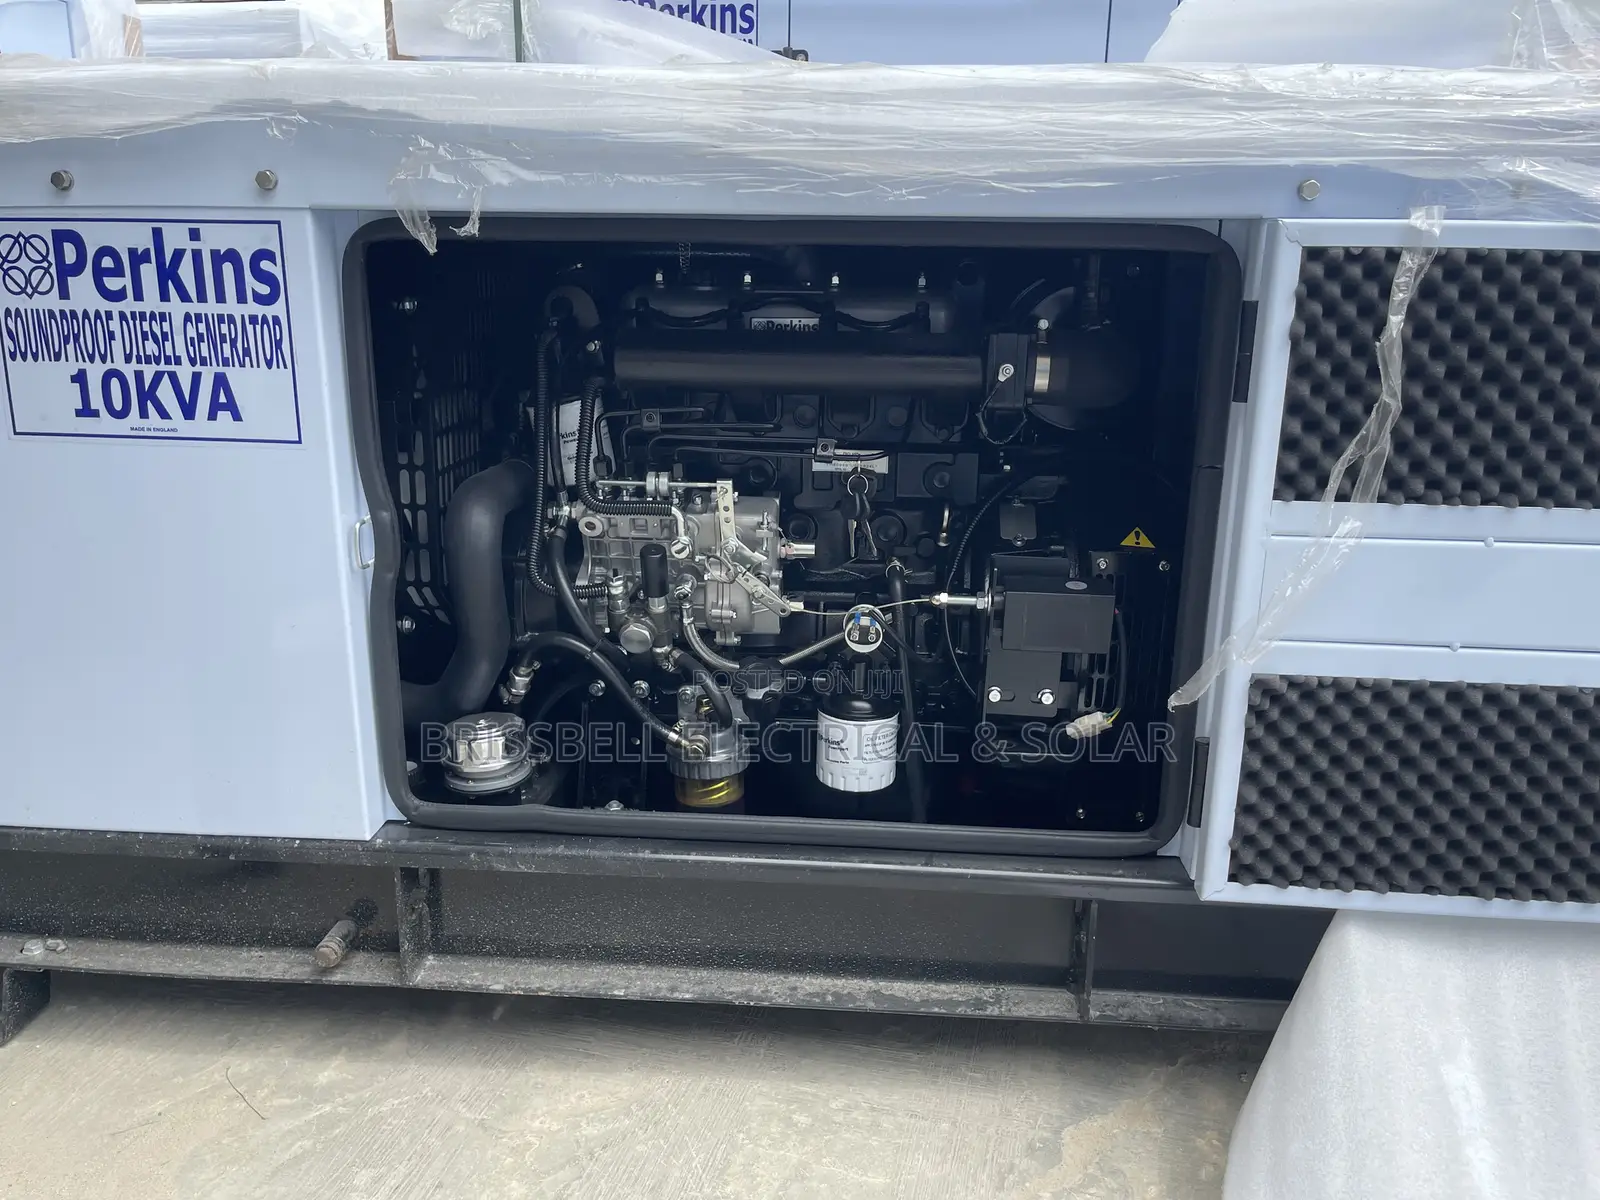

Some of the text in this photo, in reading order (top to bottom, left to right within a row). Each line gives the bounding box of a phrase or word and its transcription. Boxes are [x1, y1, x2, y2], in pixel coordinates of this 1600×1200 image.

[51, 227, 281, 306] Perkins
[4, 307, 288, 370] SOUNDPROOF DIESEL GENERATOR
[70, 368, 243, 422] 10KVA
